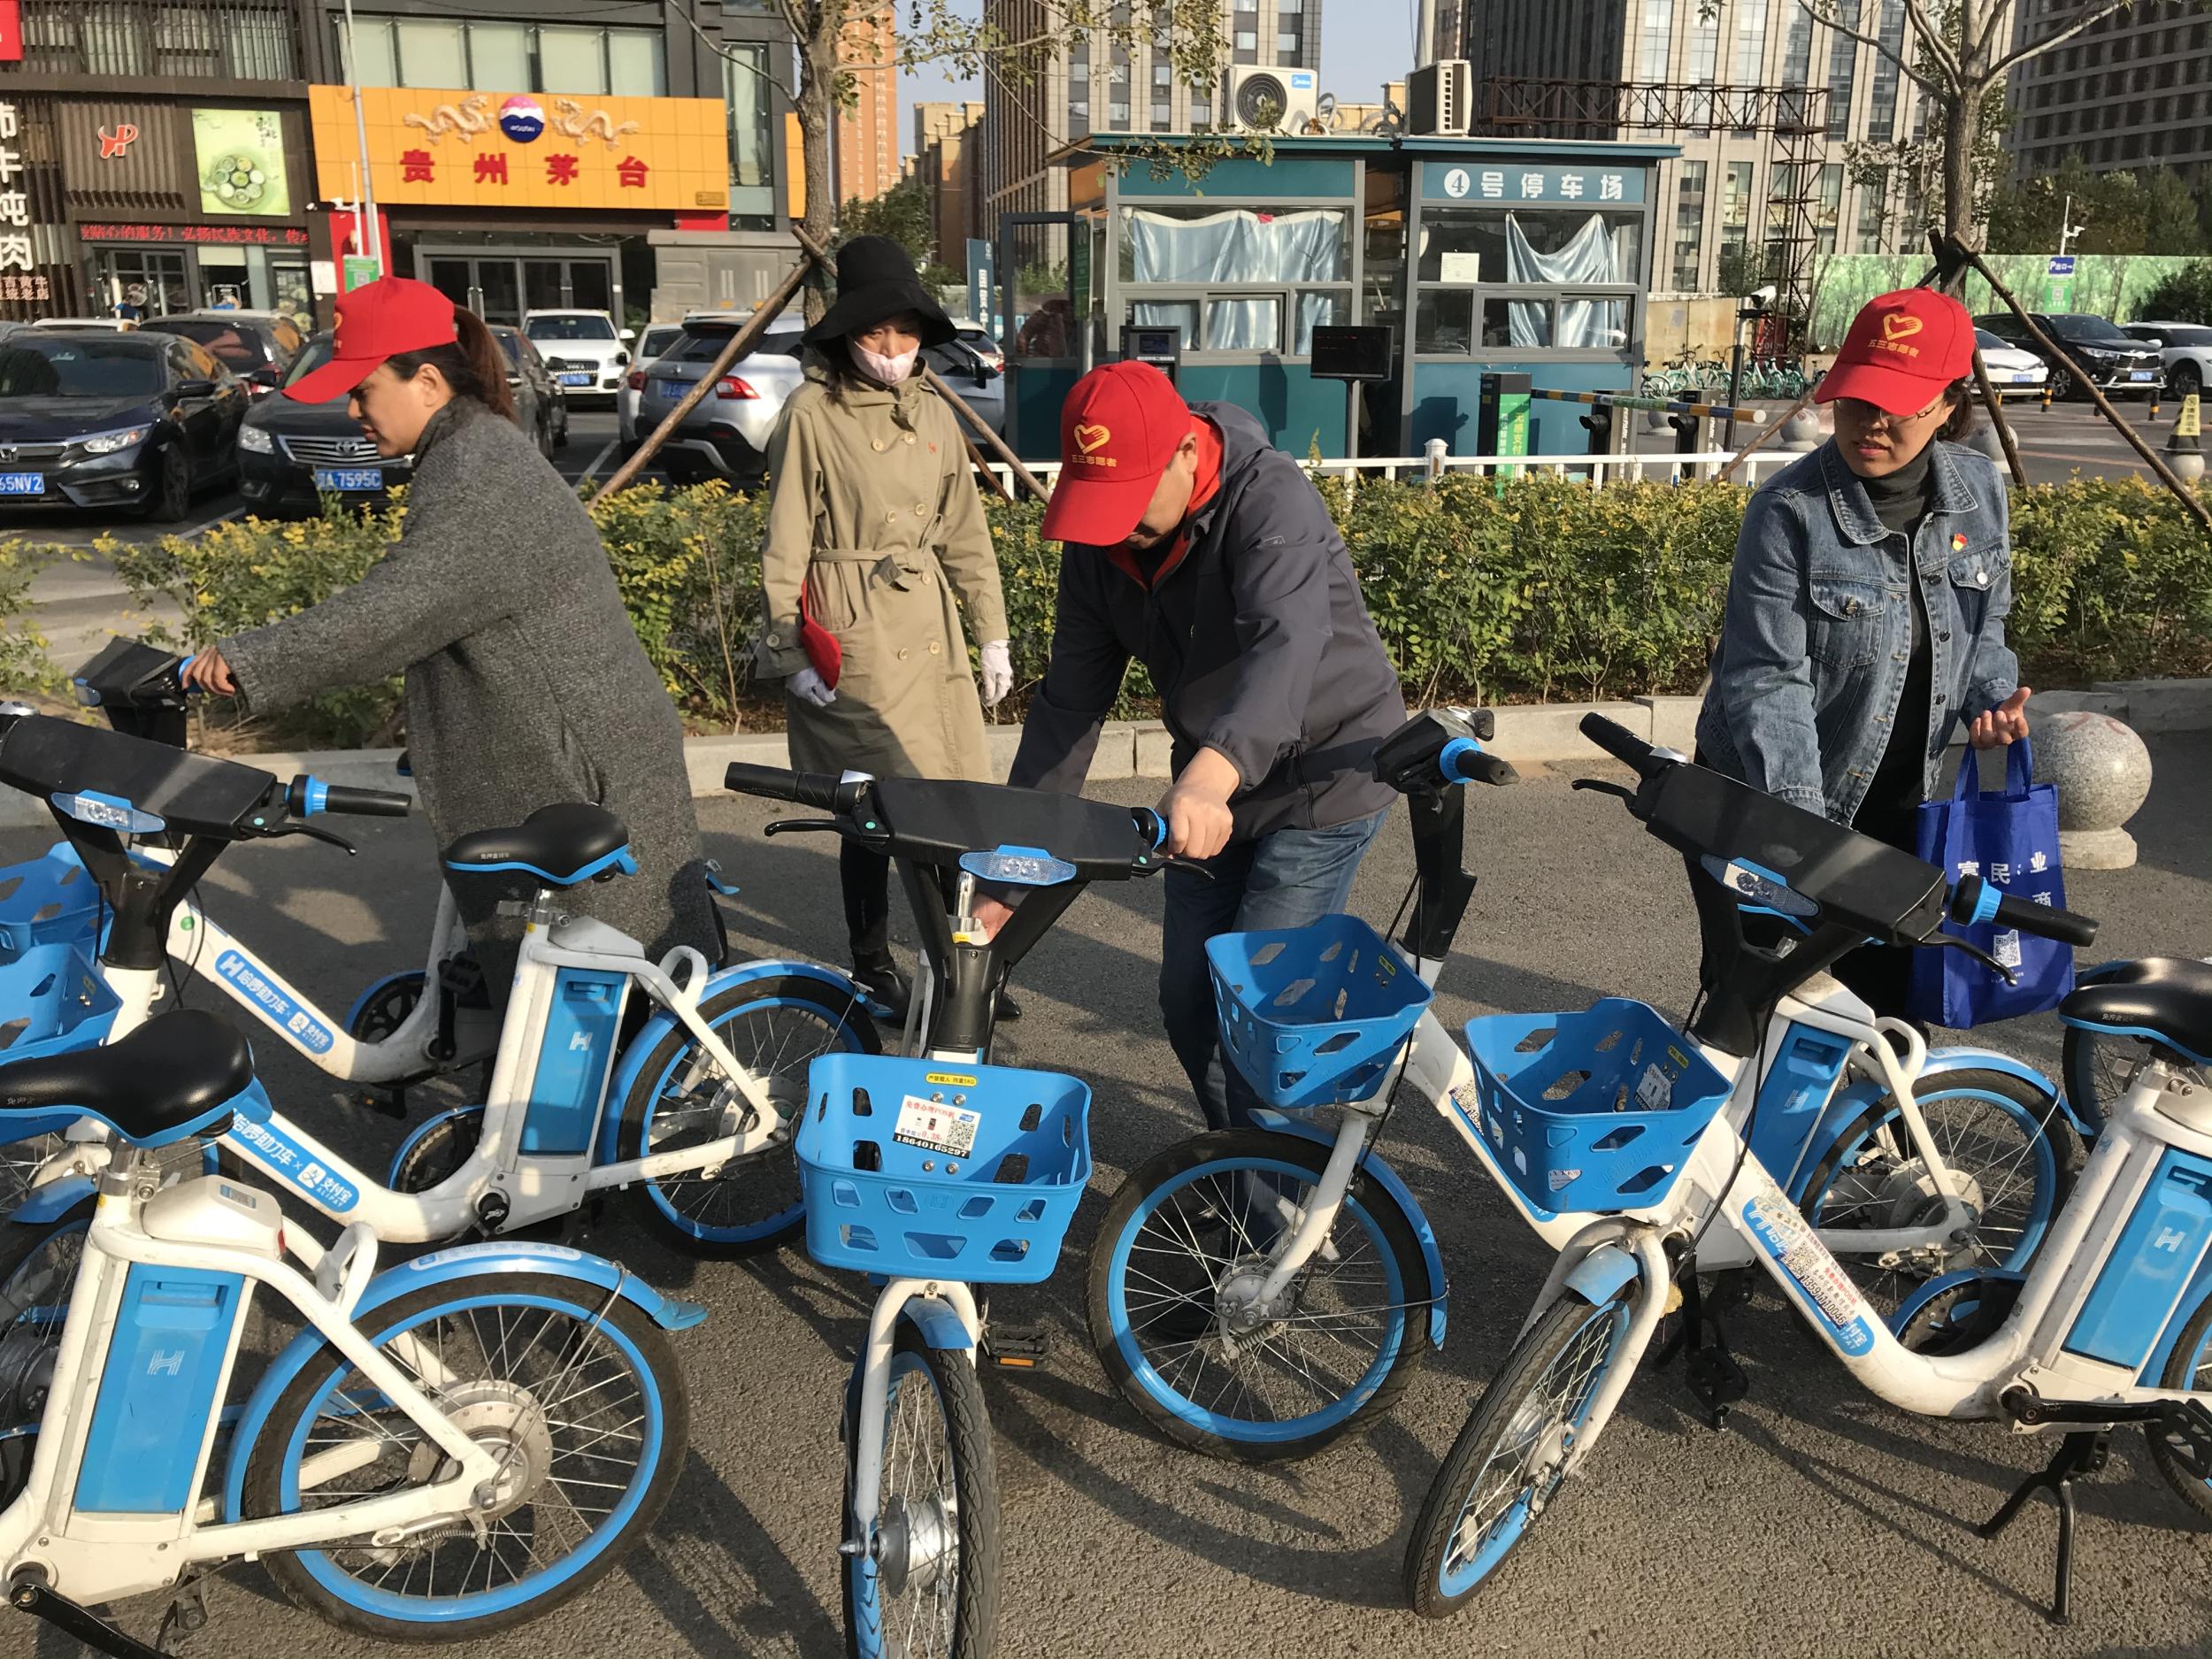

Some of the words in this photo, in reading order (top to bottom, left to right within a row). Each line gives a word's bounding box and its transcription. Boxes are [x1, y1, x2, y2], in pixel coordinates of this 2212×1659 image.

[400, 150, 649, 188] 贵州茅台
[1868, 340, 1919, 358] 五三志愿者
[1071, 455, 1118, 467] 五三志愿者
[233, 1112, 297, 1165] 哈啰助力车
[896, 1135, 968, 1157] 18640165297
[316, 1187, 344, 1208] ALIPAY
[319, 1177, 353, 1203] 支付宝
[1802, 1275, 1847, 1325] 13591110046
